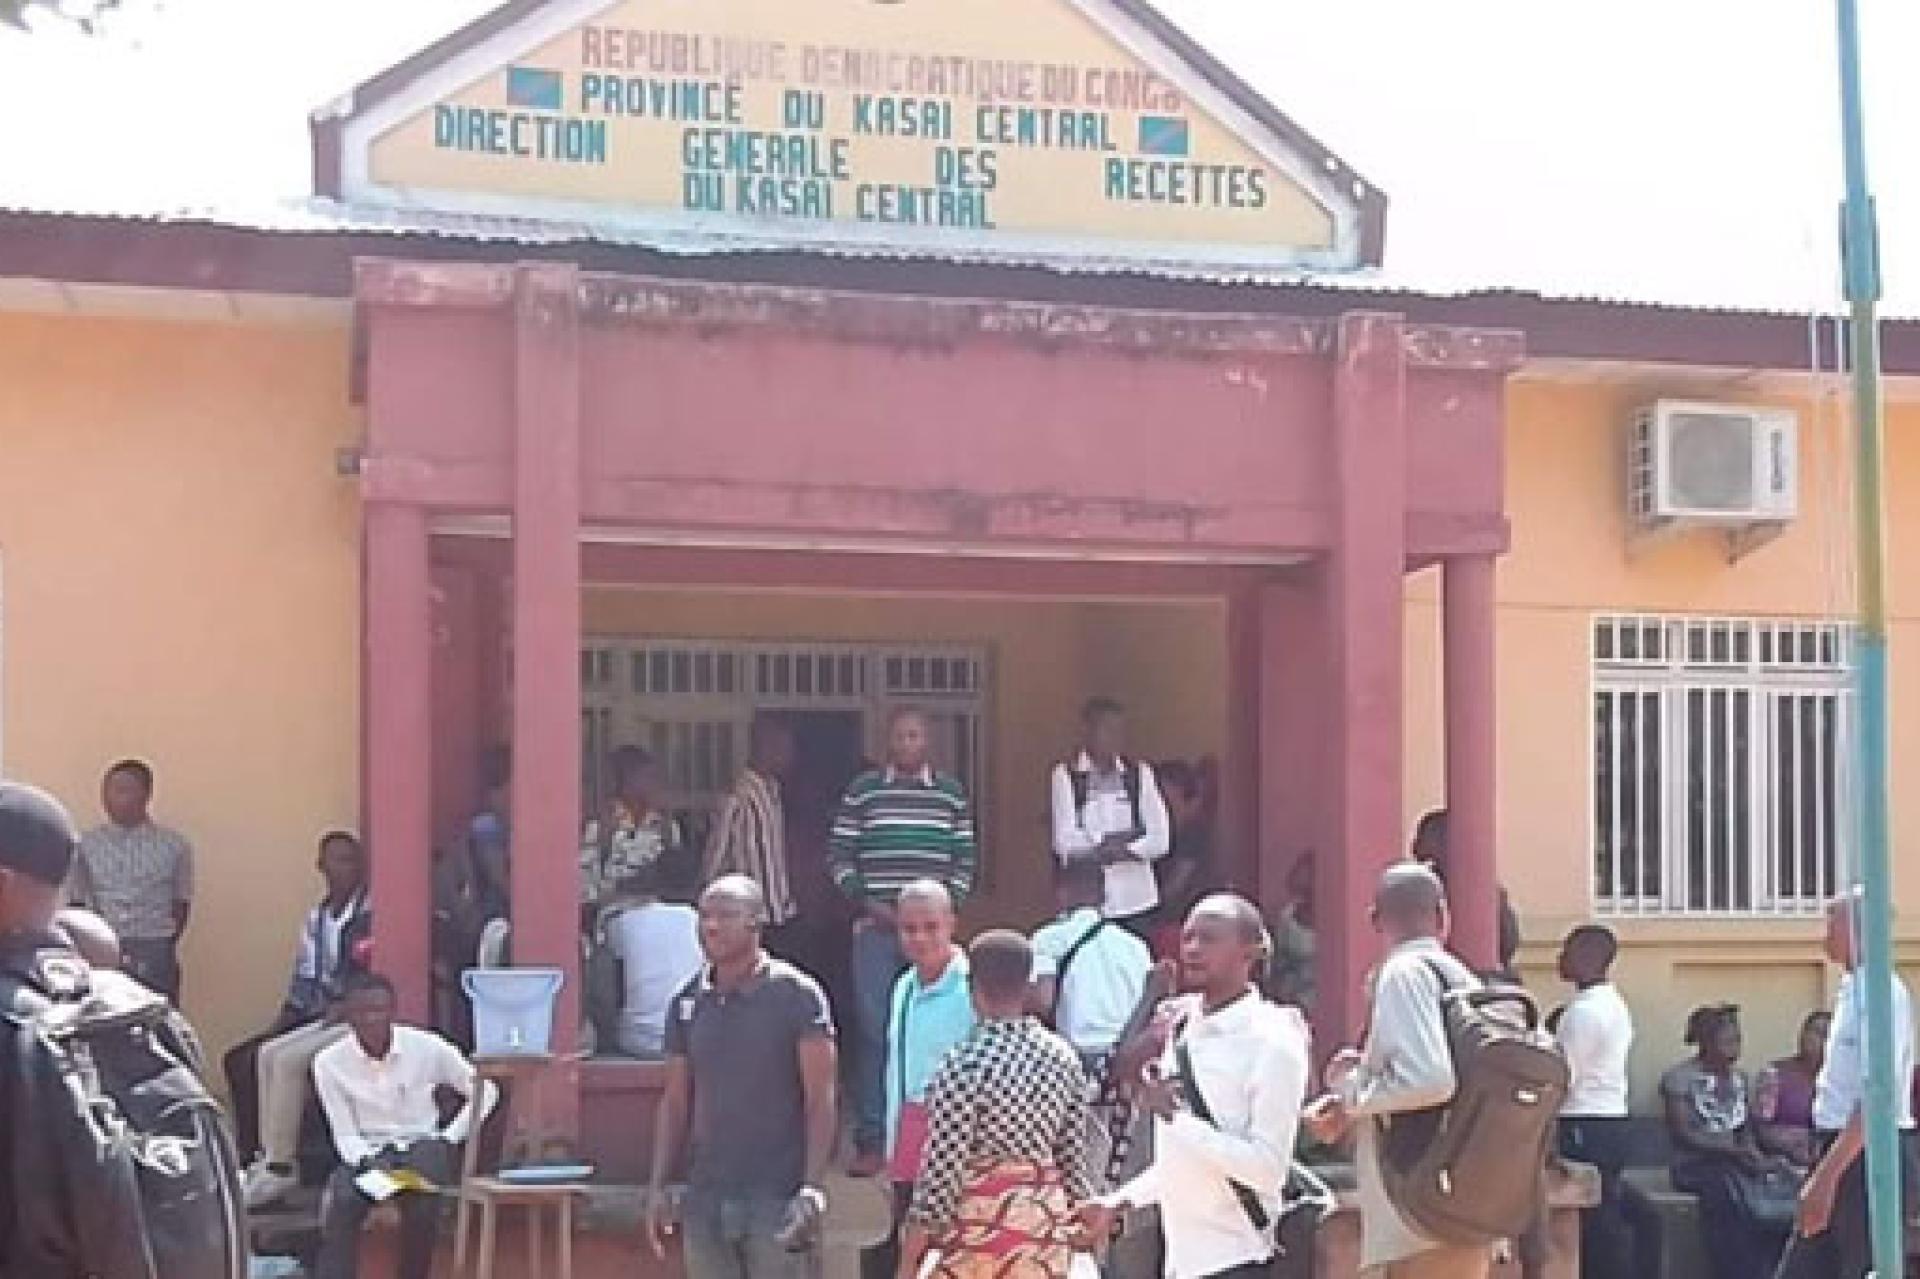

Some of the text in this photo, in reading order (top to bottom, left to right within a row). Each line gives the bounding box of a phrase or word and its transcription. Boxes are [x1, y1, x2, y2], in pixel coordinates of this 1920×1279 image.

[581, 73, 1116, 151] PROVINCE DU KASAI CENTRAL
[434, 105, 1264, 207] DIRECTION GENERALE DES RECETTES
[683, 173, 995, 229] DU KASAI CENTRAL
